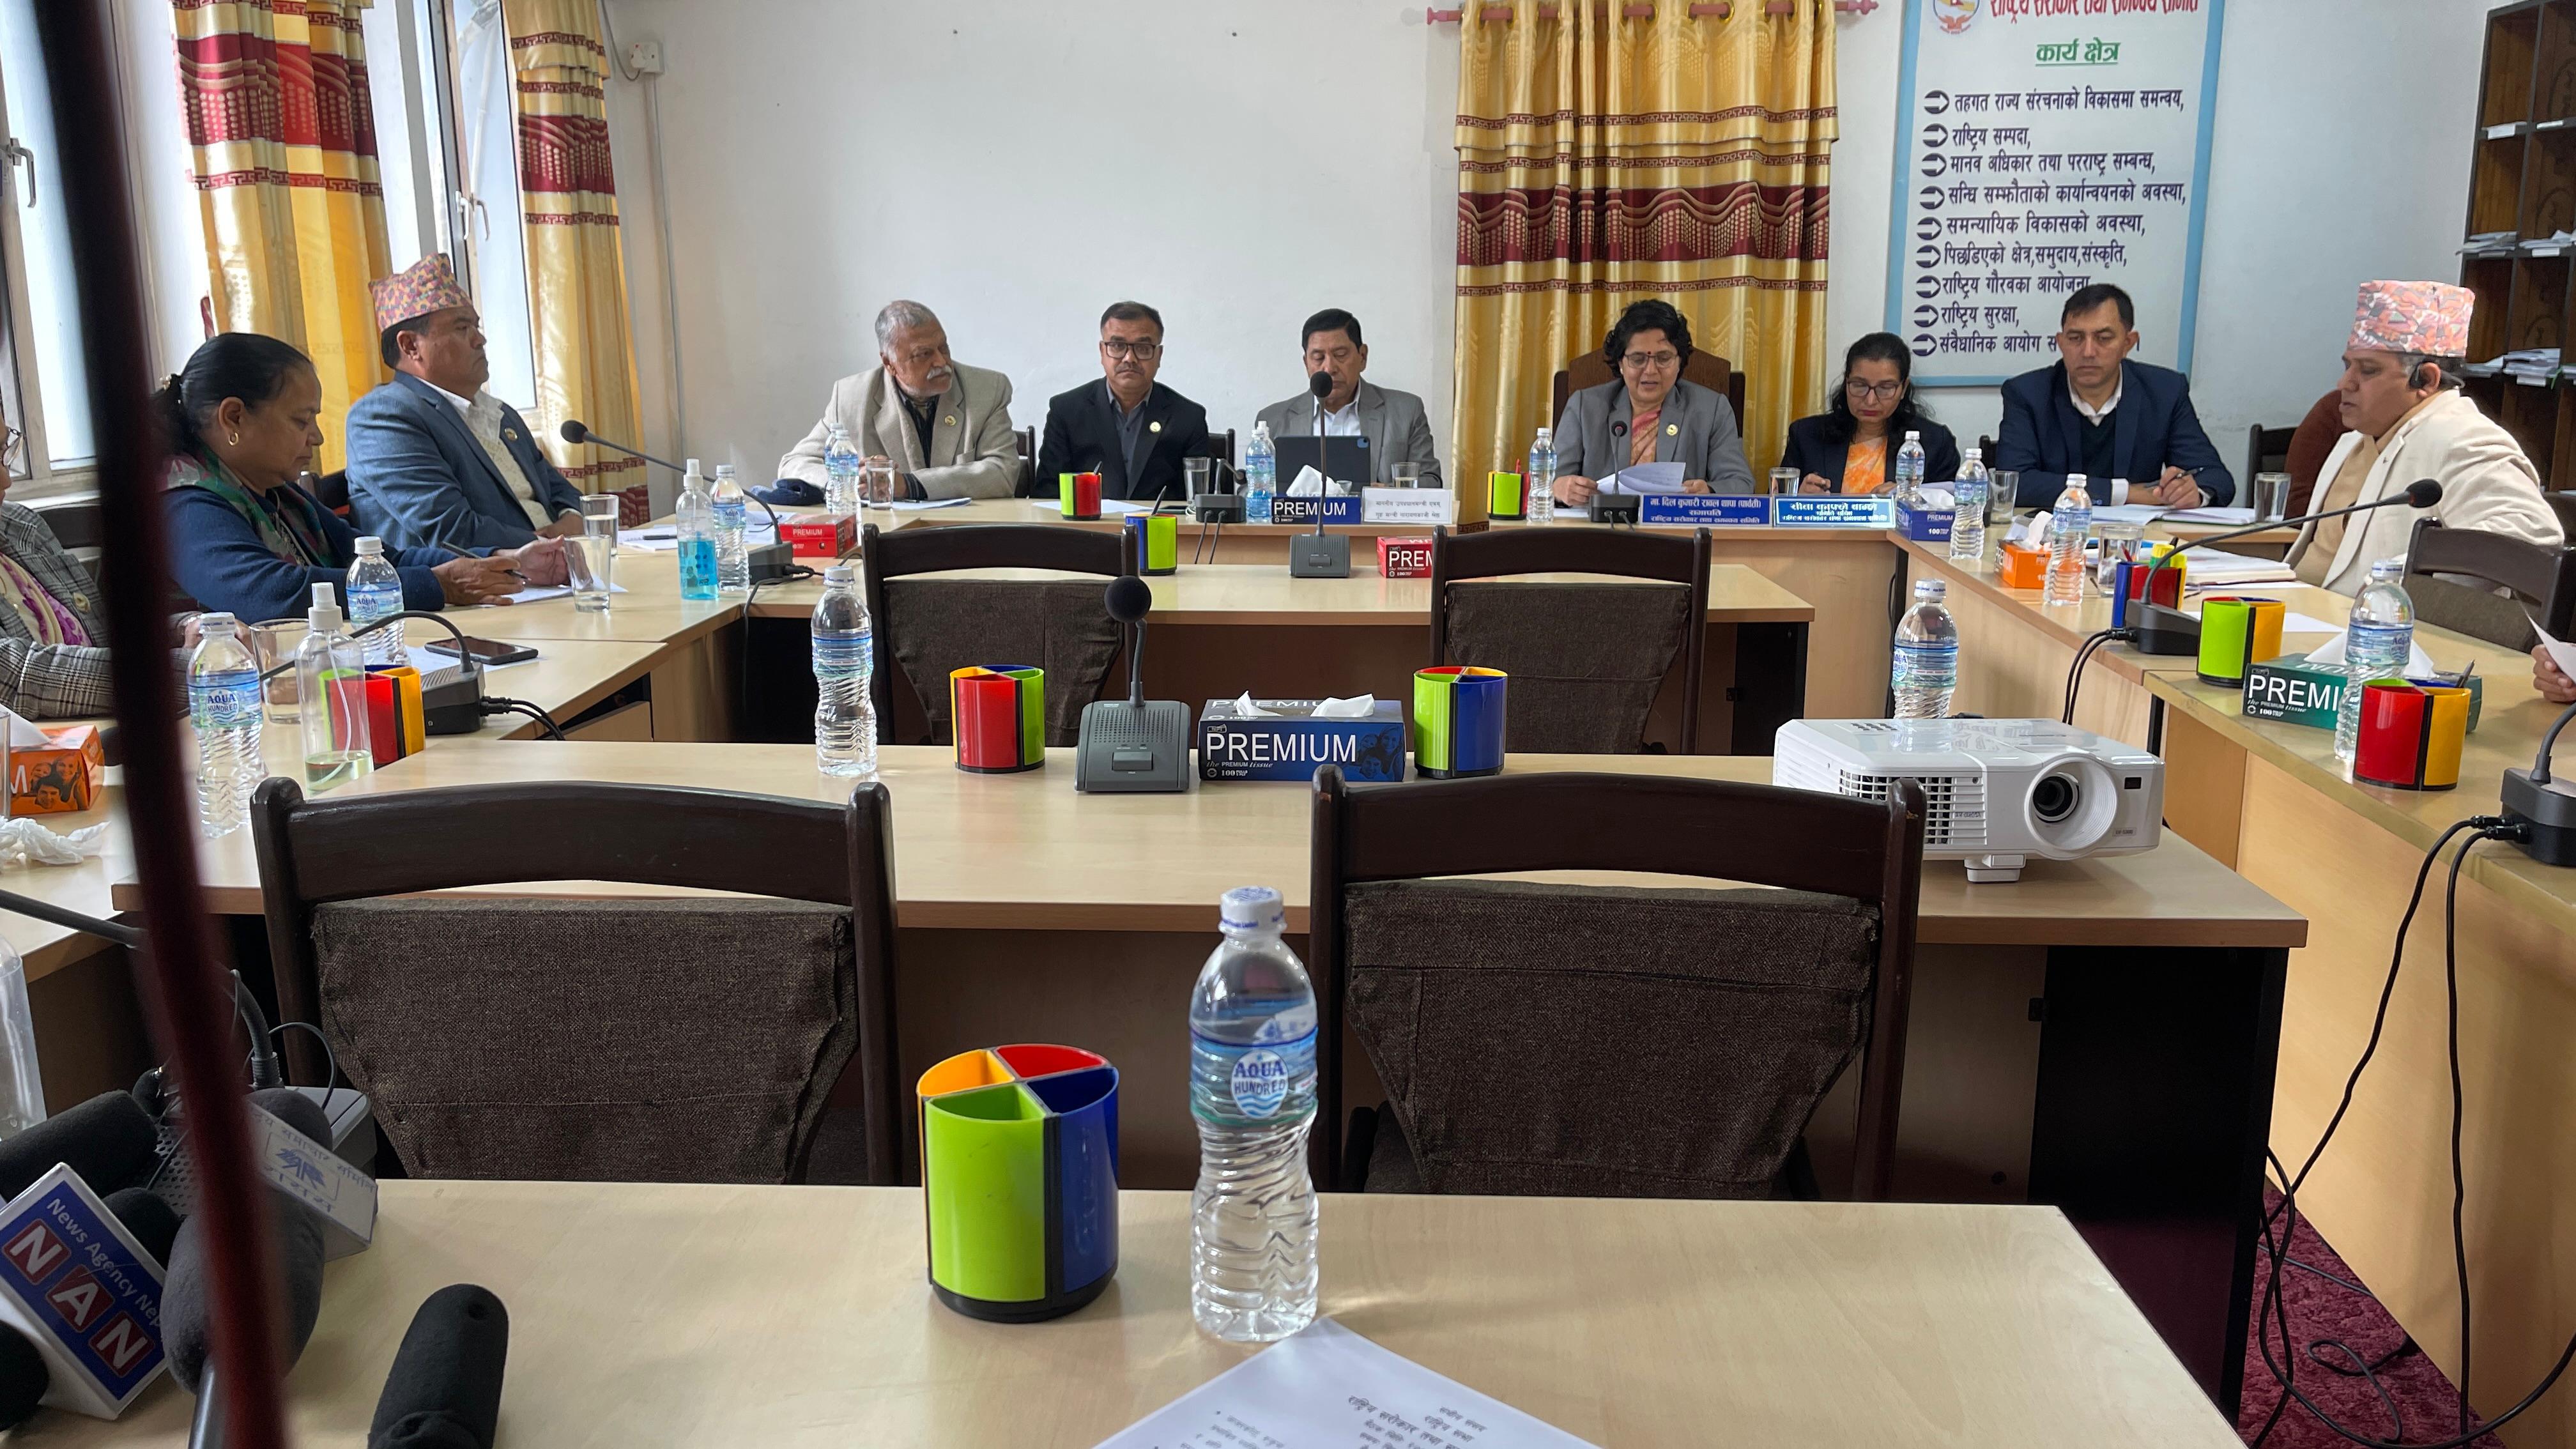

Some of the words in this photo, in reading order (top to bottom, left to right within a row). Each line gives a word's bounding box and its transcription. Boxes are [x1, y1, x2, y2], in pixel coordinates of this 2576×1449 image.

[2035, 38, 2079, 61] कार्य
[2084, 37, 2120, 63] क्षेत्र
[1954, 94, 1990, 112] तहगत
[1995, 93, 2021, 111] राज्य
[2026, 86, 2080, 111] संरचनाको
[2085, 84, 2135, 109] विकासमा
[2140, 89, 2184, 112] समन्वय,
[1952, 121, 1988, 152] राष्ट्रिय
[1993, 127, 2030, 150] सम्पदा,
[1951, 155, 1983, 173] मानव
[1988, 148, 2034, 173] अधिकार
[2039, 155, 2062, 172] तथा
[2067, 153, 2107, 177] परराष्ट्र
[2113, 152, 2155, 175] सम्बन्ध,
[1948, 180, 1979, 204] सन्धि
[1984, 178, 2050, 204] सम्झौताको
[2056, 178, 2136, 203] कार्यान्वयनको
[2142, 183, 2186, 206] अवस्था,
[1947, 210, 2020, 234] समन्यायिक
[2027, 210, 2089, 233] विकासको
[2096, 215, 2145, 237] अवस्था,
[1942, 271, 1981, 298] राष्ट्रिय
[1986, 269, 2032, 295] गौरवका
[1941, 301, 1979, 329] राष्ट्रिय
[1984, 306, 2020, 330] सुरक्षा,
[1940, 328, 1998, 353] संवैधानिक
[2004, 330, 2042, 352] आयोग
[1274, 502, 1346, 516] PREMUM
[1389, 550, 1432, 567] PREM
[208, 694, 236, 703] AQUA
[2248, 674, 2339, 711] PREMI
[208, 703, 237, 712] HUNDRED
[1206, 733, 1356, 762] PREMIUM
[1234, 1061, 1284, 1077] AQUA
[1234, 1078, 1285, 1095] HUNDRED
[47, 1198, 88, 1243] News
[84, 1242, 137, 1298] Agency
[135, 1294, 160, 1328] Nep
